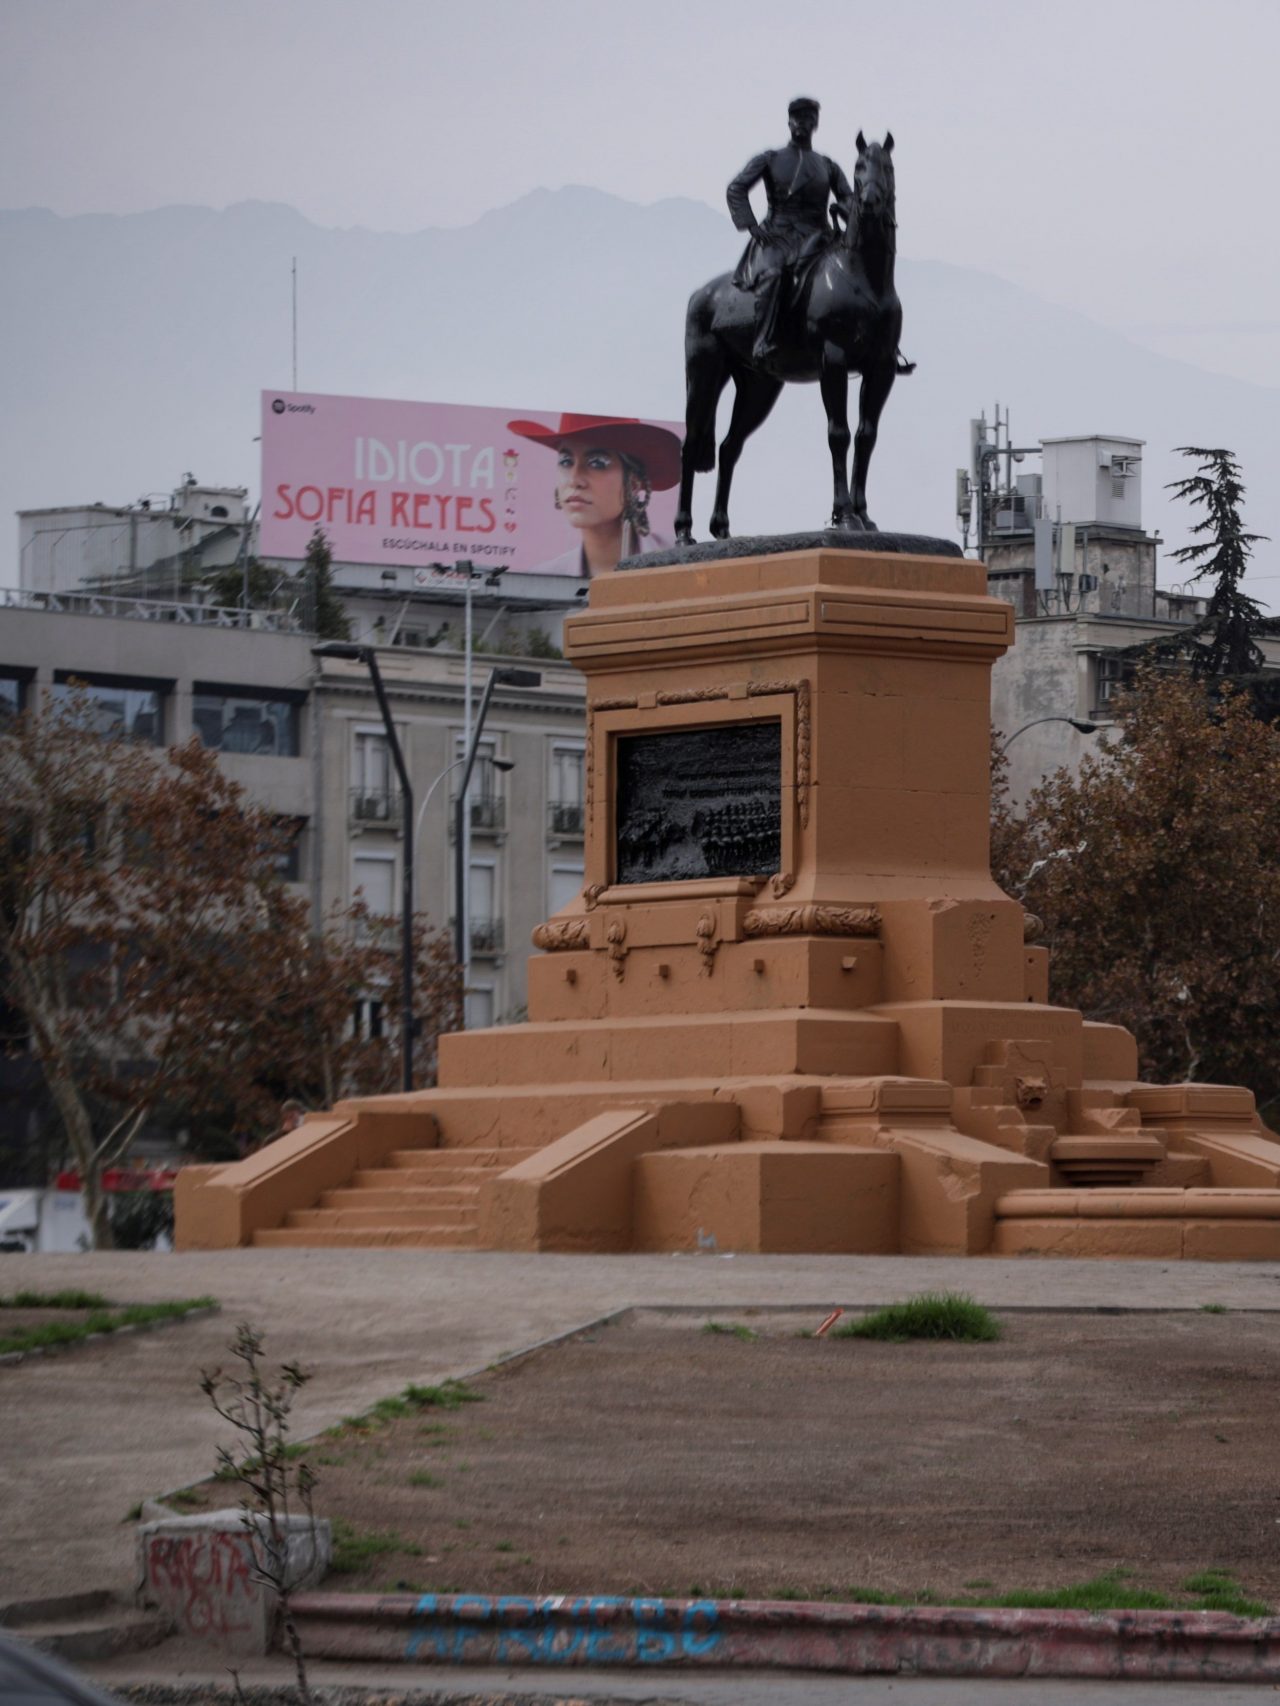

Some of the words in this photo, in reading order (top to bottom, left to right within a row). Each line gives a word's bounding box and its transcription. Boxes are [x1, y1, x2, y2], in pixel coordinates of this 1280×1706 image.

[354, 437, 496, 489] IDIOTA
[273, 484, 378, 525] SOFIA
[390, 491, 497, 533] REYES
[382, 537, 450, 552] ESCÚCHALA
[453, 543, 468, 553] EN
[470, 544, 517, 556] SPOTIFY
[404, 1593, 724, 1664] APRUEBO
